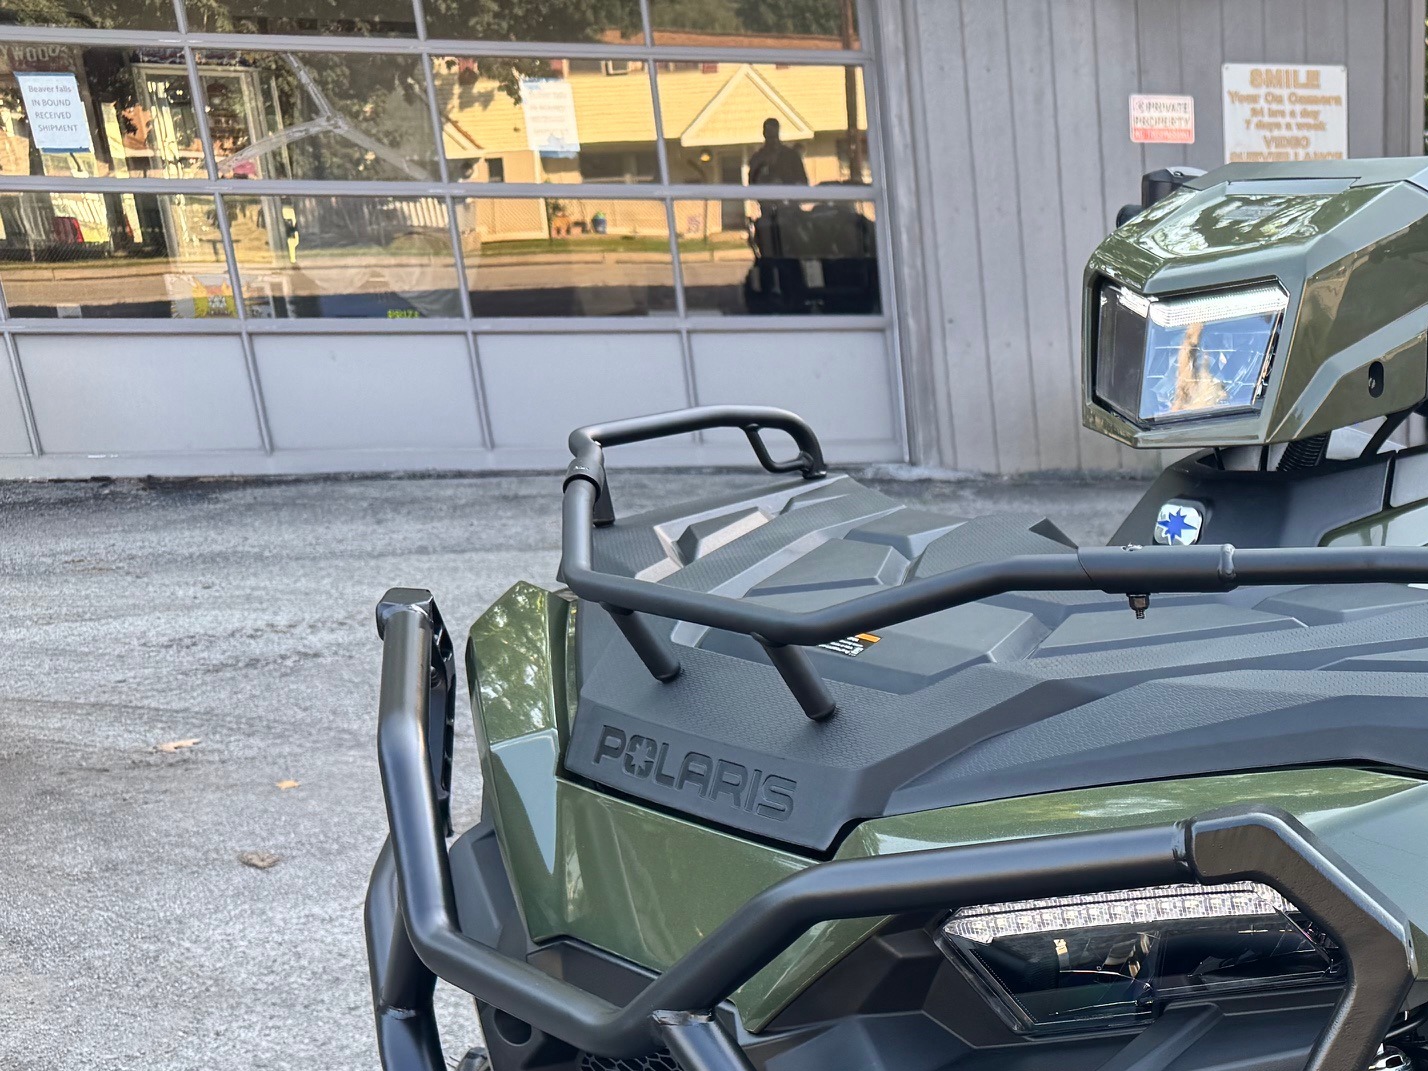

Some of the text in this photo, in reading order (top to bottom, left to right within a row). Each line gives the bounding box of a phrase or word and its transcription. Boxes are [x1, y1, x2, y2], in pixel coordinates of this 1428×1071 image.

[1249, 68, 1321, 89] SMILE
[28, 85, 54, 93] Beaver
[32, 99, 71, 107] IN BOUND
[1264, 91, 1284, 105] On
[1288, 91, 1342, 106] Camera
[1146, 102, 1188, 114] PRIVATE
[34, 111, 72, 119] RECEIVED
[38, 124, 78, 132] SHIPMENT
[1133, 115, 1190, 129] PROPERTY
[1263, 134, 1311, 149] VIDEO
[591, 724, 798, 822] POLARIS
